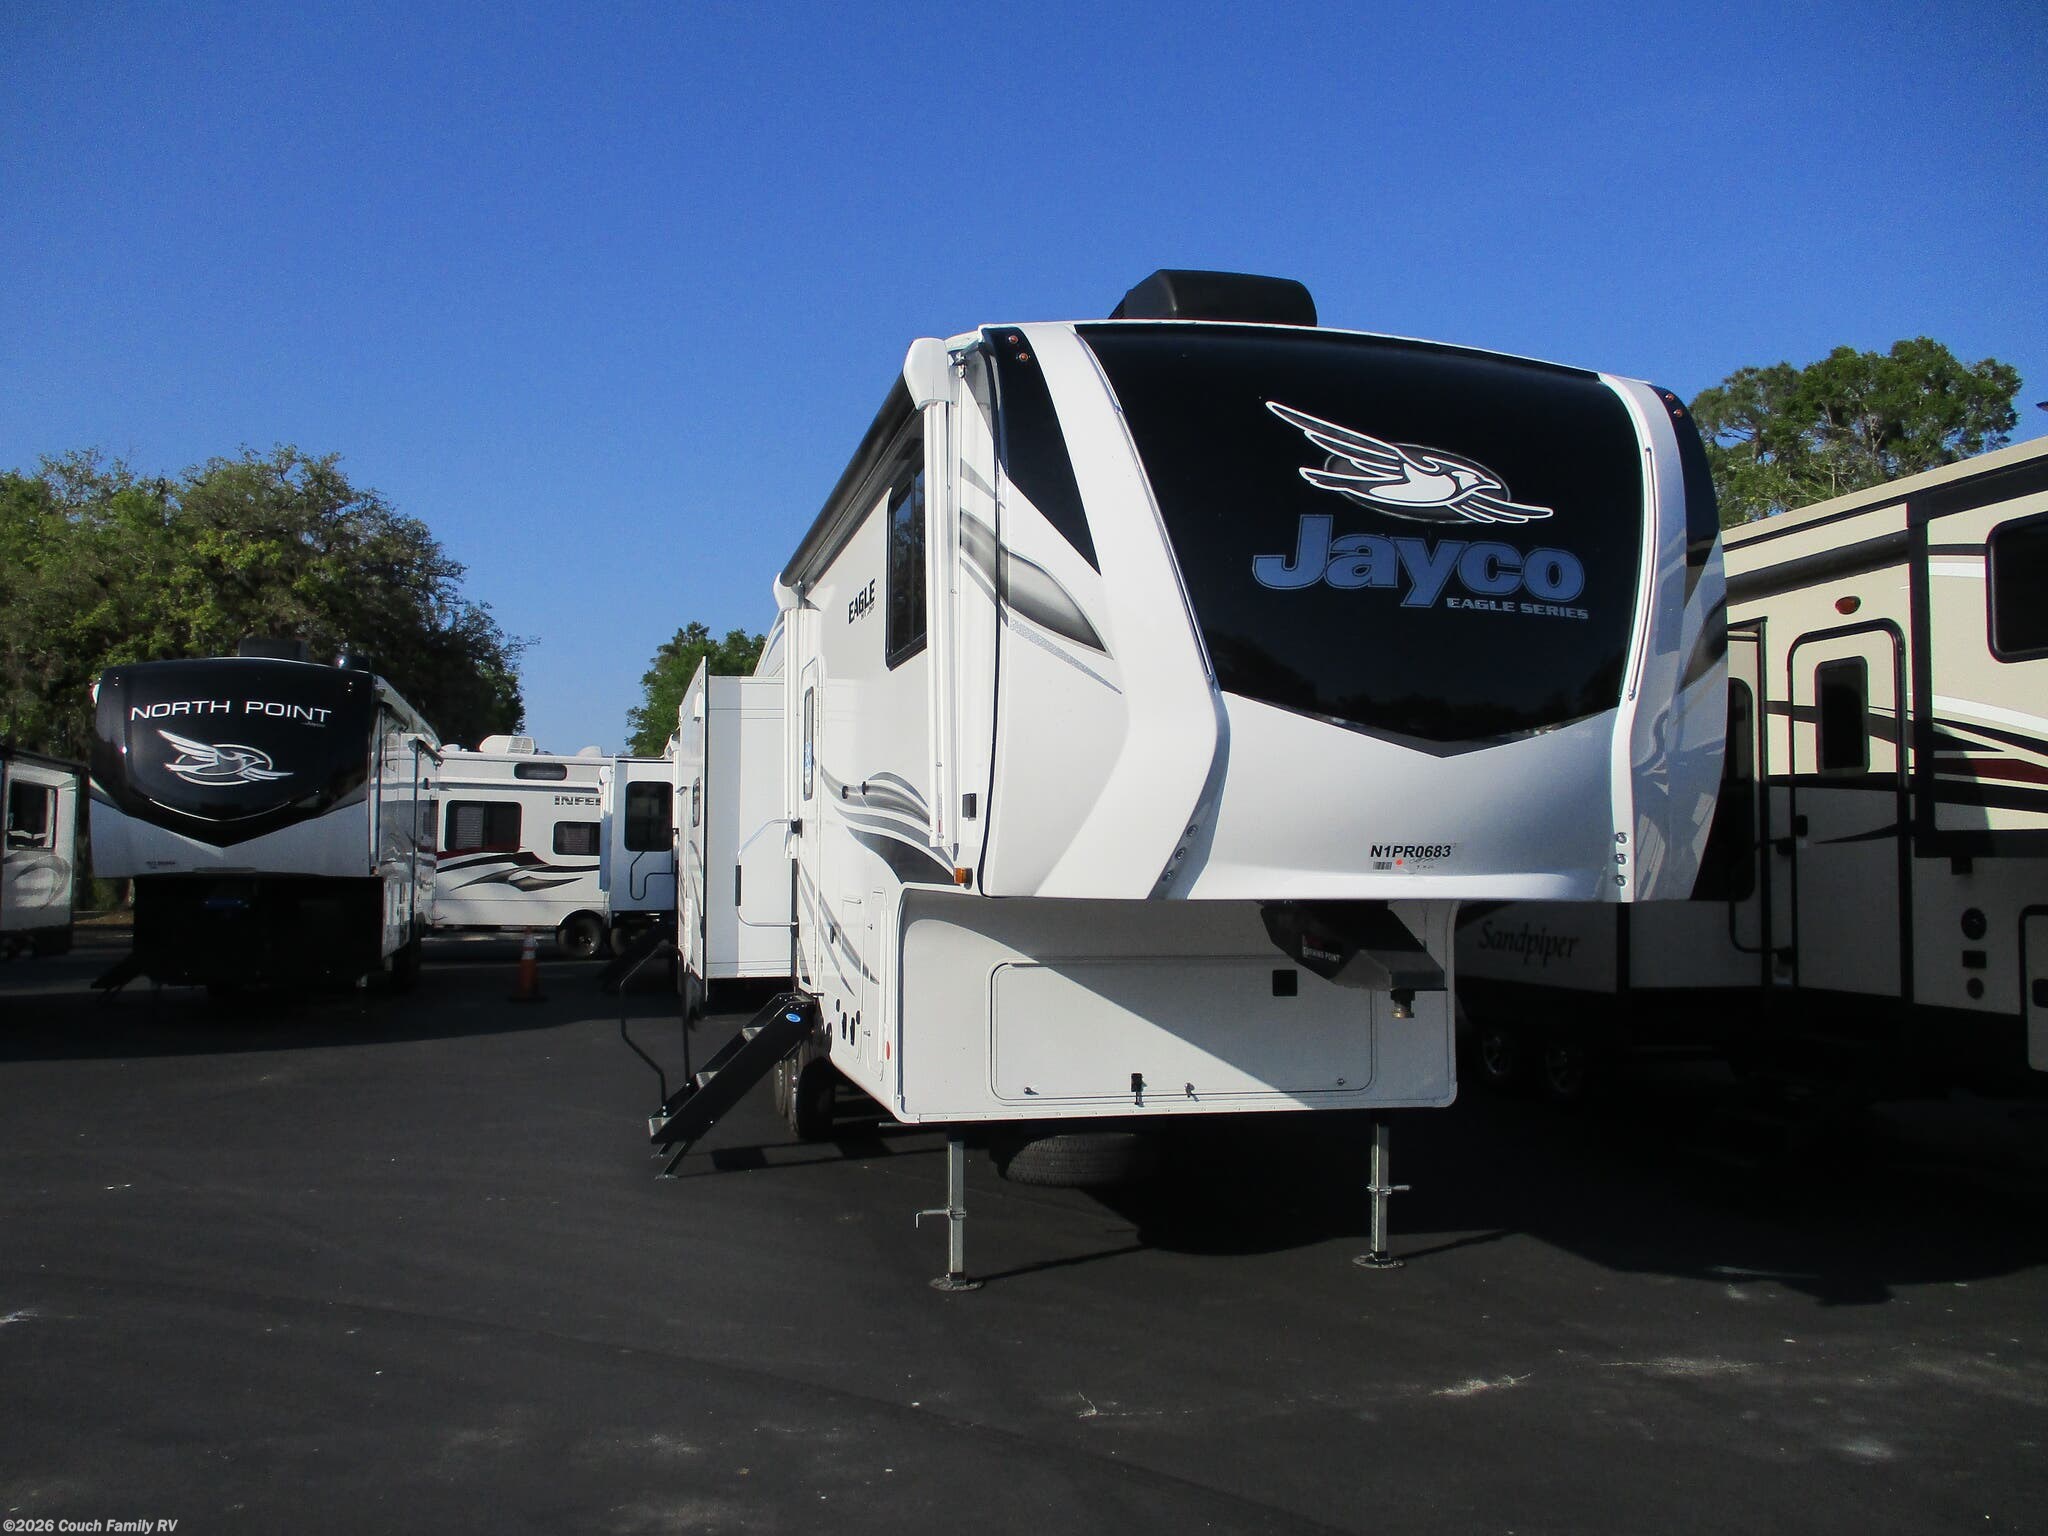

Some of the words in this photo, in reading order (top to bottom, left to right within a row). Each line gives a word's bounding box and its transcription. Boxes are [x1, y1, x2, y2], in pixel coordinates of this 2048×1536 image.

[1252, 514, 1585, 608] Jayco
[848, 577, 876, 625] EAGLE
[1446, 597, 1516, 613] EAGLE
[1519, 602, 1589, 620] SERIES
[130, 700, 231, 721] NORTH
[245, 700, 332, 723] POINT
[1370, 844, 1452, 859] N1PR0683
[1478, 920, 1581, 969] Sandpiper
